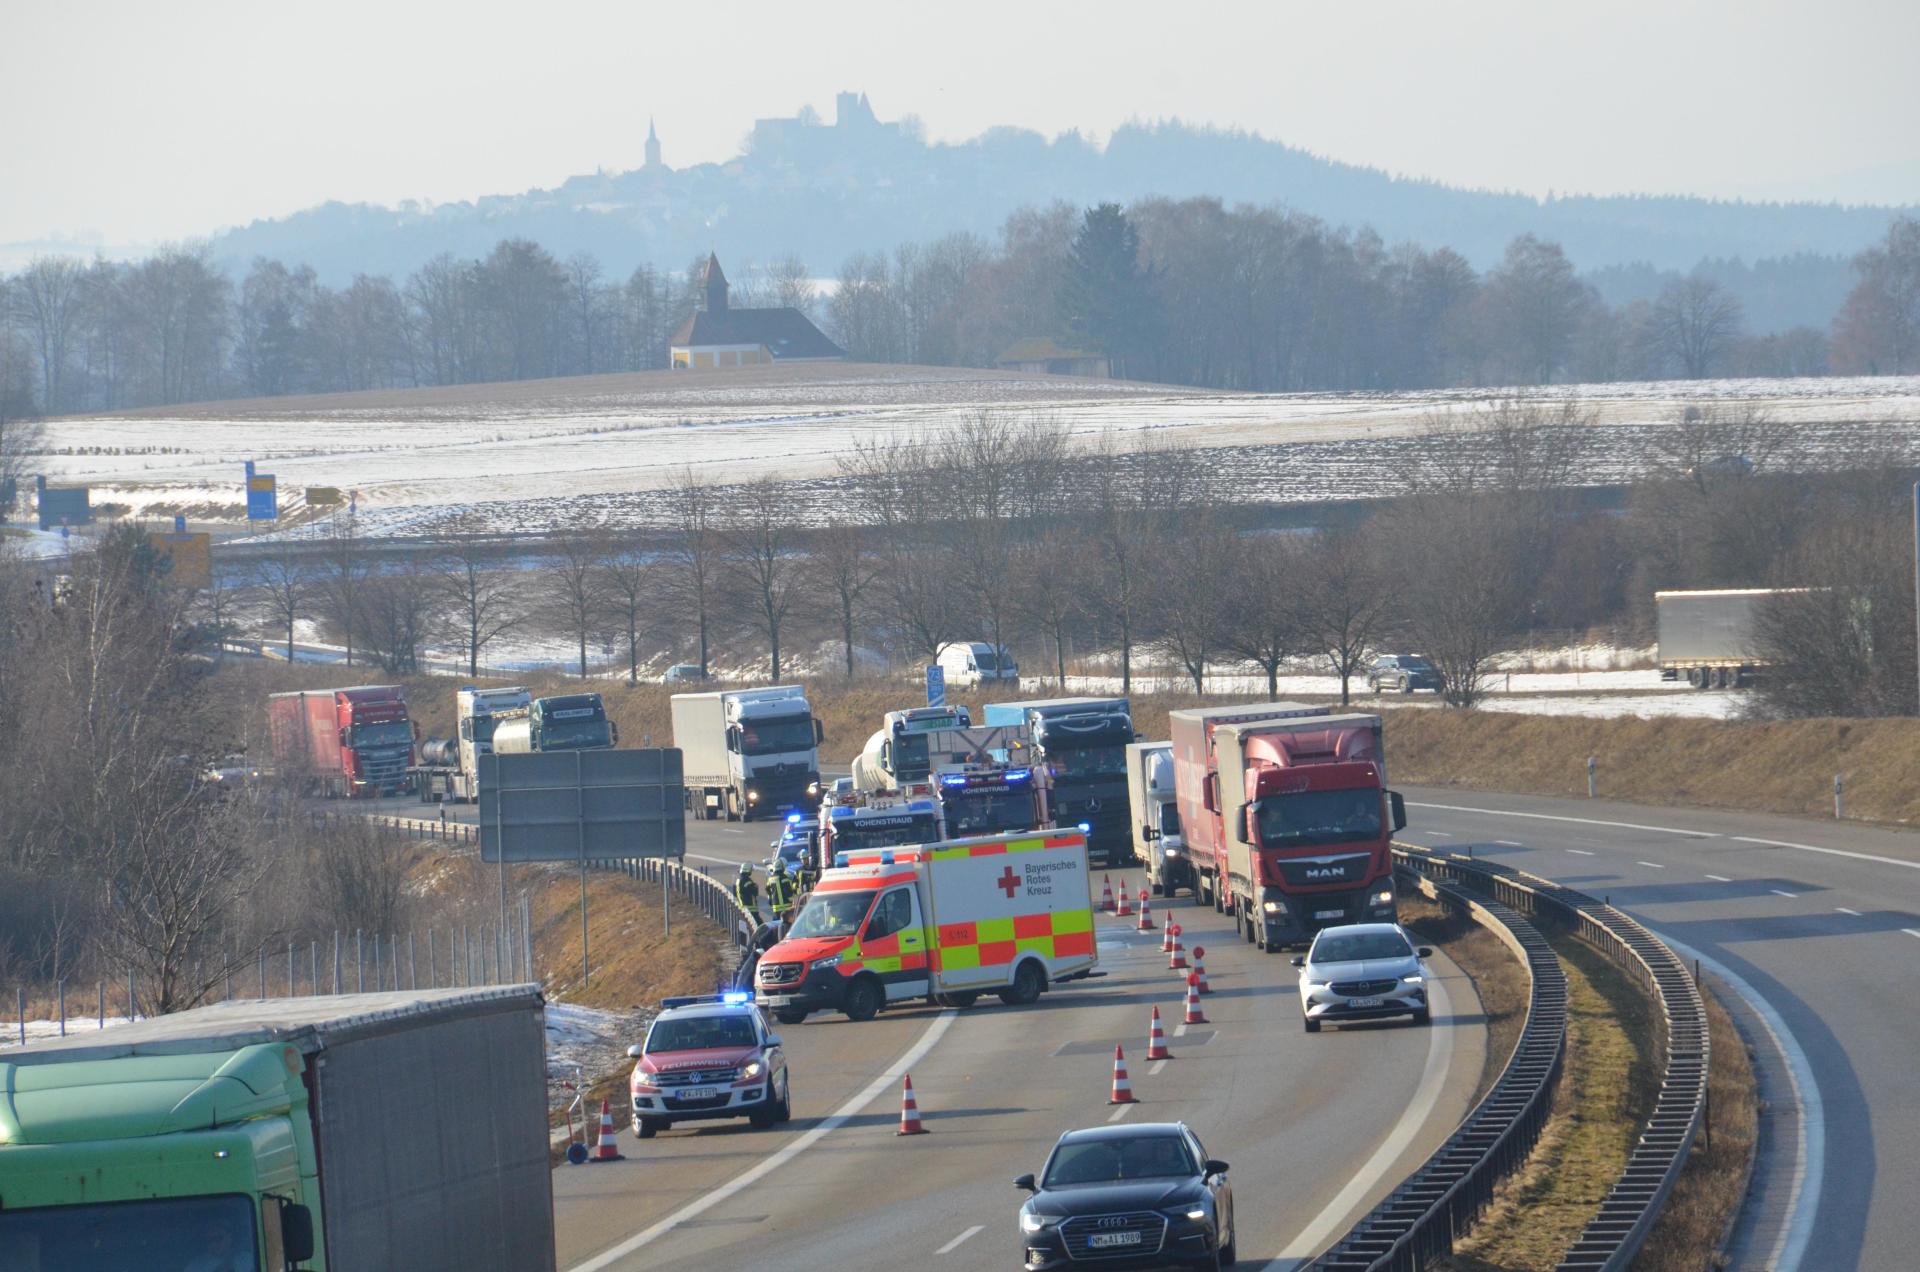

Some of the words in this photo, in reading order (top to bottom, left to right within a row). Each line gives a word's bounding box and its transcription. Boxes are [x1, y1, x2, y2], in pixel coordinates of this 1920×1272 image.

[1025, 860, 1077, 876] Bayerisches
[1306, 867, 1345, 878] MAN
[1026, 874, 1051, 885] Rotes
[1027, 886, 1052, 896] Kreuz
[661, 1060, 731, 1070] FEUERWEHR
[1092, 1235, 1103, 1247] NM
[1121, 1232, 1140, 1243] 1989
